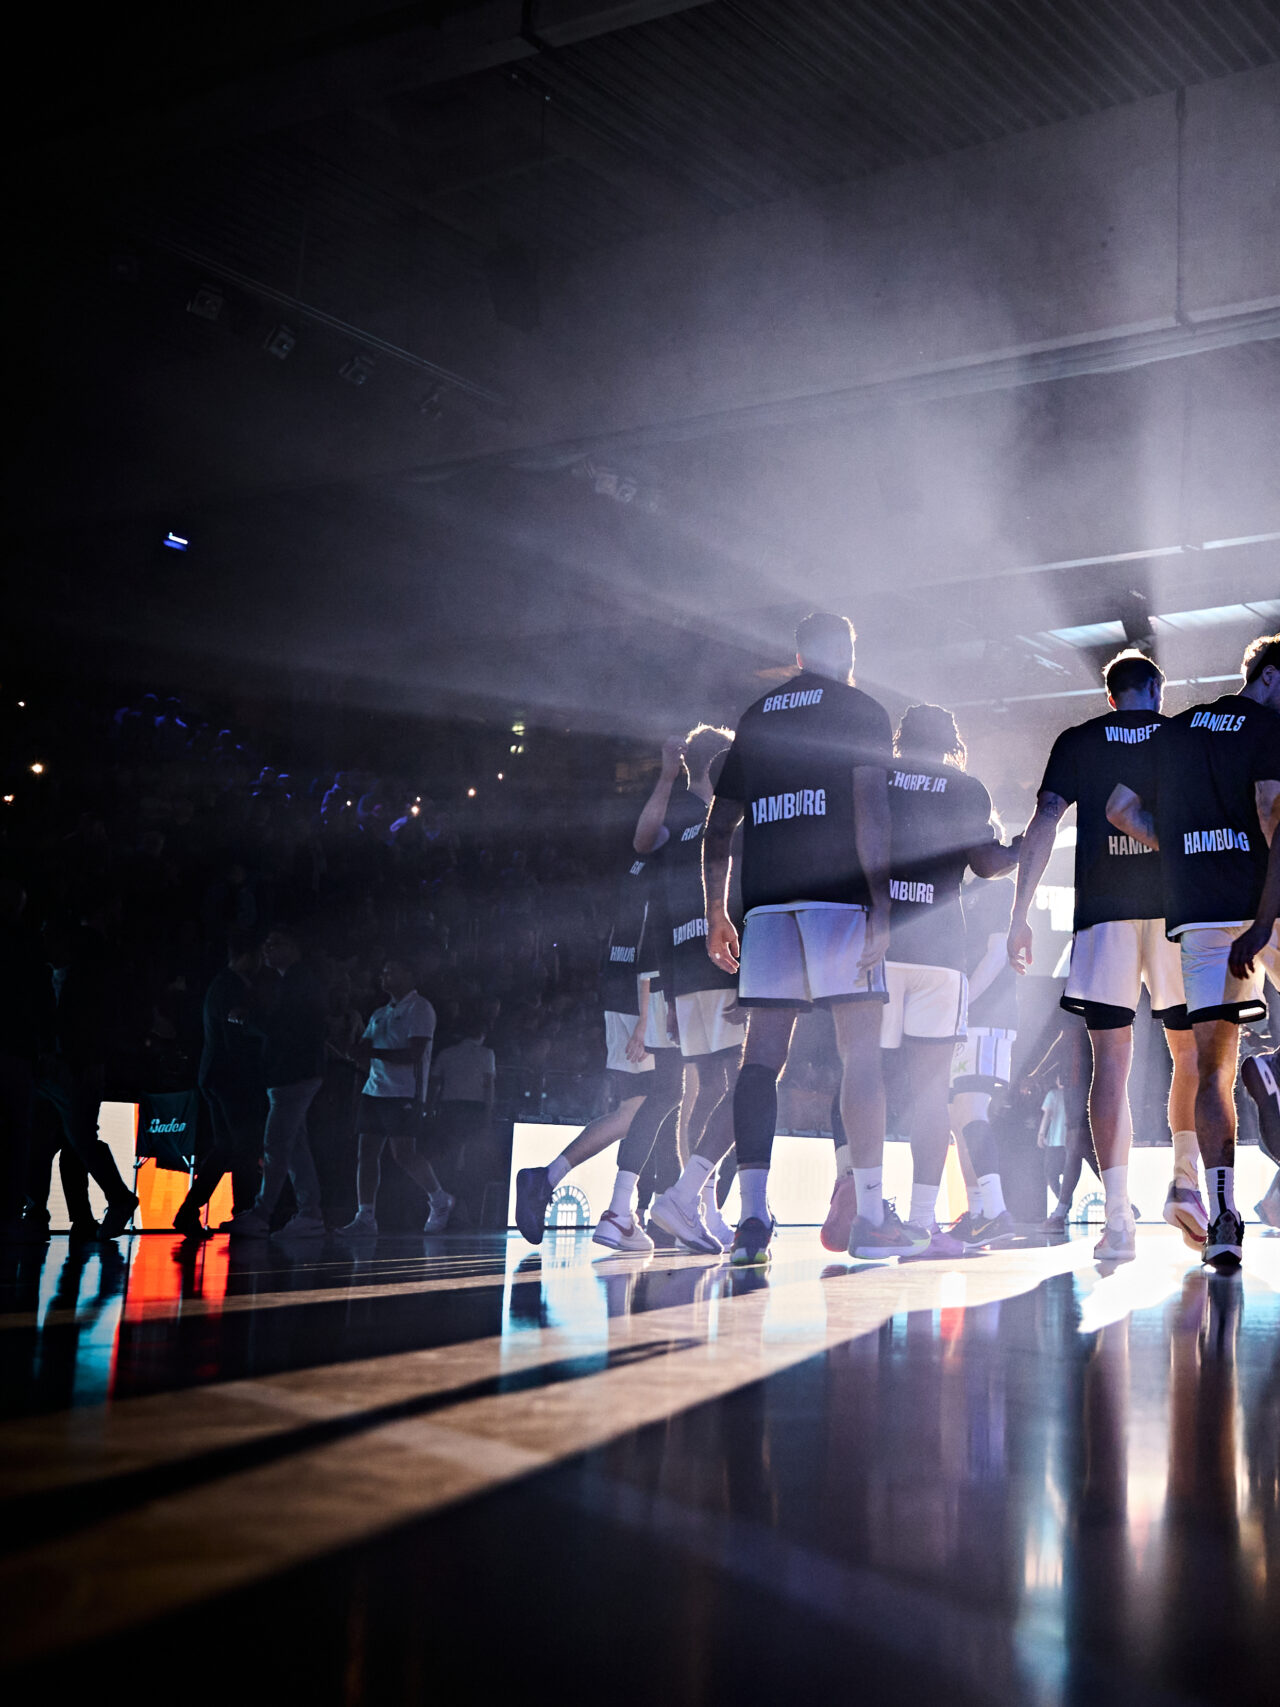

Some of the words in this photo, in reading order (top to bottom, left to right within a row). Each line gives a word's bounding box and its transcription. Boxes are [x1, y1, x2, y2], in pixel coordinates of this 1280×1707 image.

[763, 688, 824, 713] BREUNIG
[1190, 711, 1247, 732] DANIELS
[1105, 723, 1162, 744] WIMBE
[930, 777, 948, 793] JR
[889, 878, 935, 904] MBURG
[147, 1117, 187, 1134] Baden
